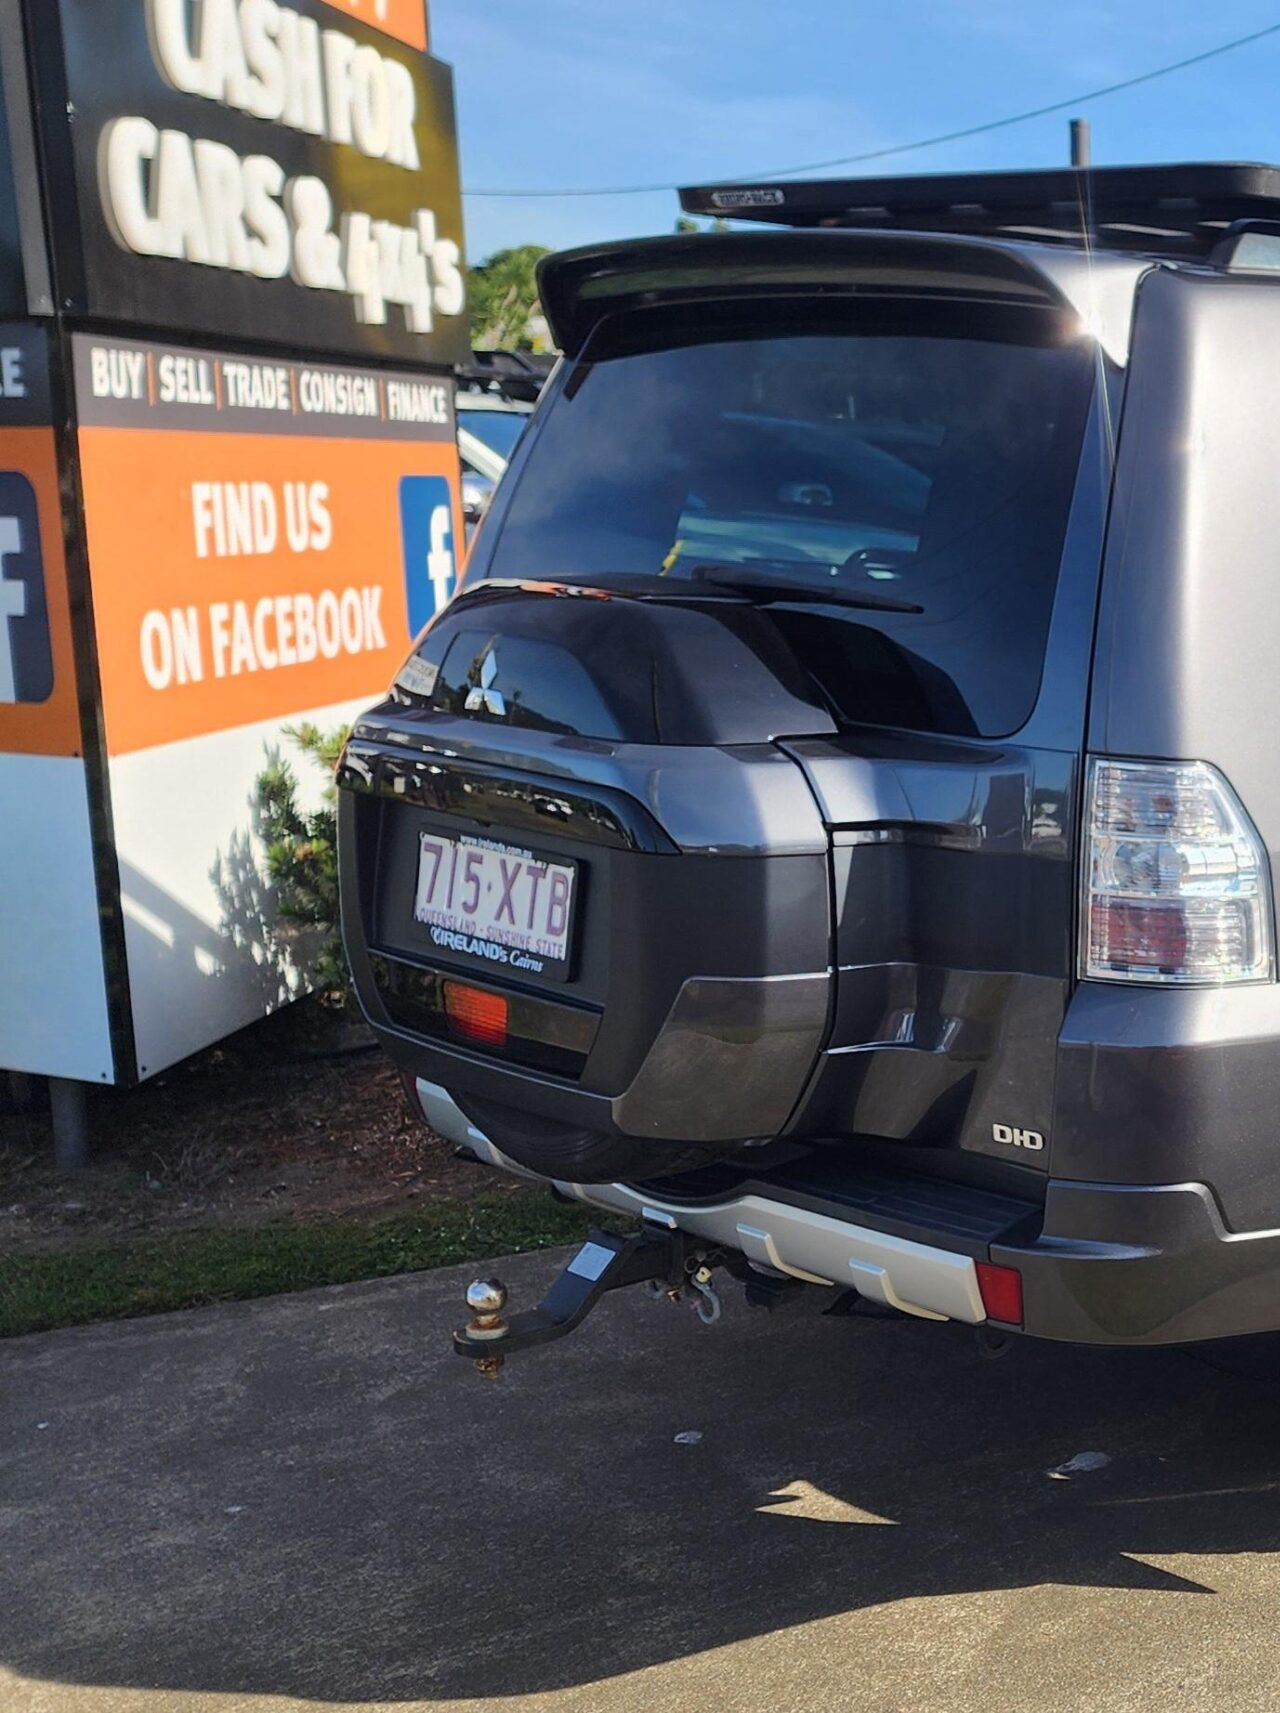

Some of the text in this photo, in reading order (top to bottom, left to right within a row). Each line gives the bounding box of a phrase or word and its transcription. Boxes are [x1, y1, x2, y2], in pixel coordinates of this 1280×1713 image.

[147, 0, 420, 170] CASH FOR
[99, 116, 290, 279] CARS
[285, 175, 346, 291] &
[91, 347, 449, 424] BUY SELL TRADE CONSIGN FINANCE
[191, 480, 333, 558] FIND US
[139, 601, 202, 690] ON
[209, 585, 387, 679] FACEBOOK
[419, 907, 477, 935] QUEENSLAND
[486, 924, 532, 950] SUNSHINE
[536, 939, 566, 961] STATE
[509, 951, 544, 973] Cairns
